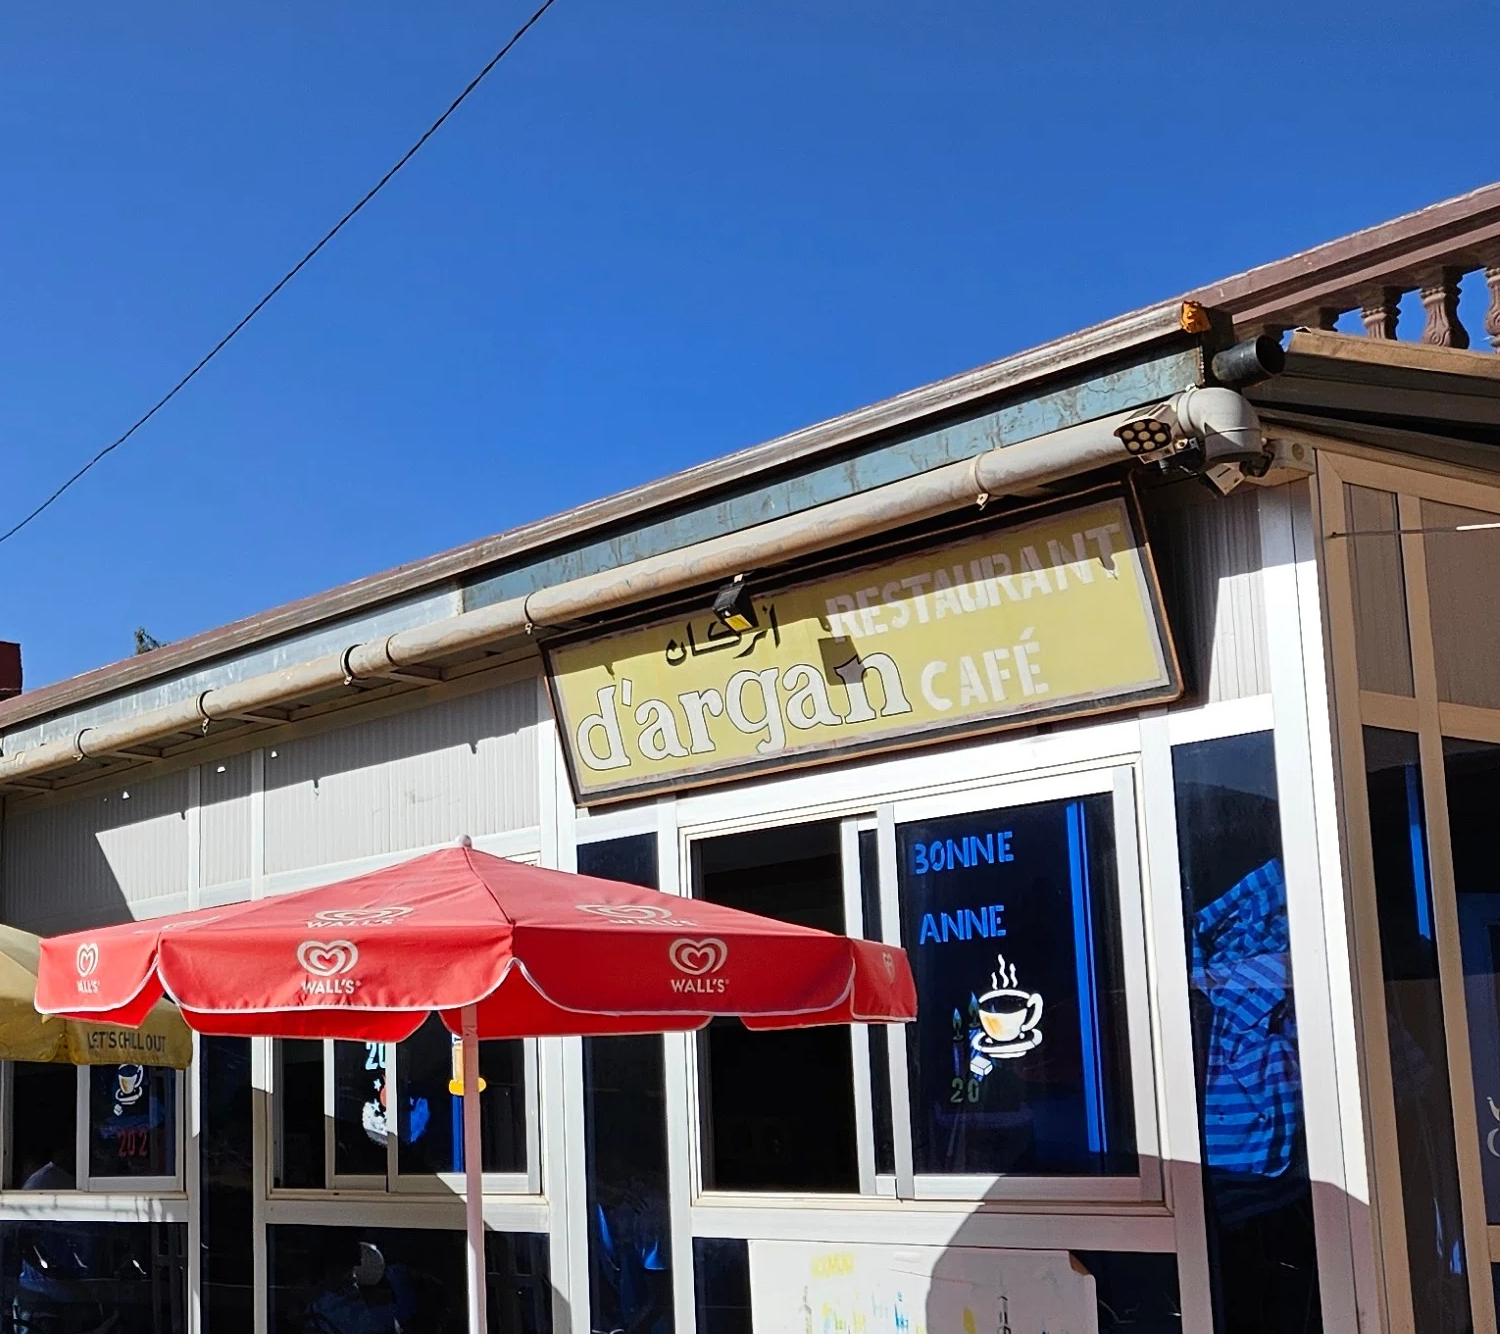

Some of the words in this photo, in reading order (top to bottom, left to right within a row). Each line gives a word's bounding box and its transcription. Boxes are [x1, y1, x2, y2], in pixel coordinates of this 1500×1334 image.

[825, 523, 1120, 643] RESTAURANT
[921, 627, 1049, 712] CAFÉ
[576, 652, 913, 771] d'argan
[911, 831, 1014, 874] BONNE
[920, 905, 1006, 945] ANNE
[301, 979, 355, 994] WALL'S
[671, 979, 725, 993] WALL'S
[87, 1031, 117, 1050] LET'S
[118, 1031, 145, 1050] CHILL
[146, 1034, 166, 1053] OUT
